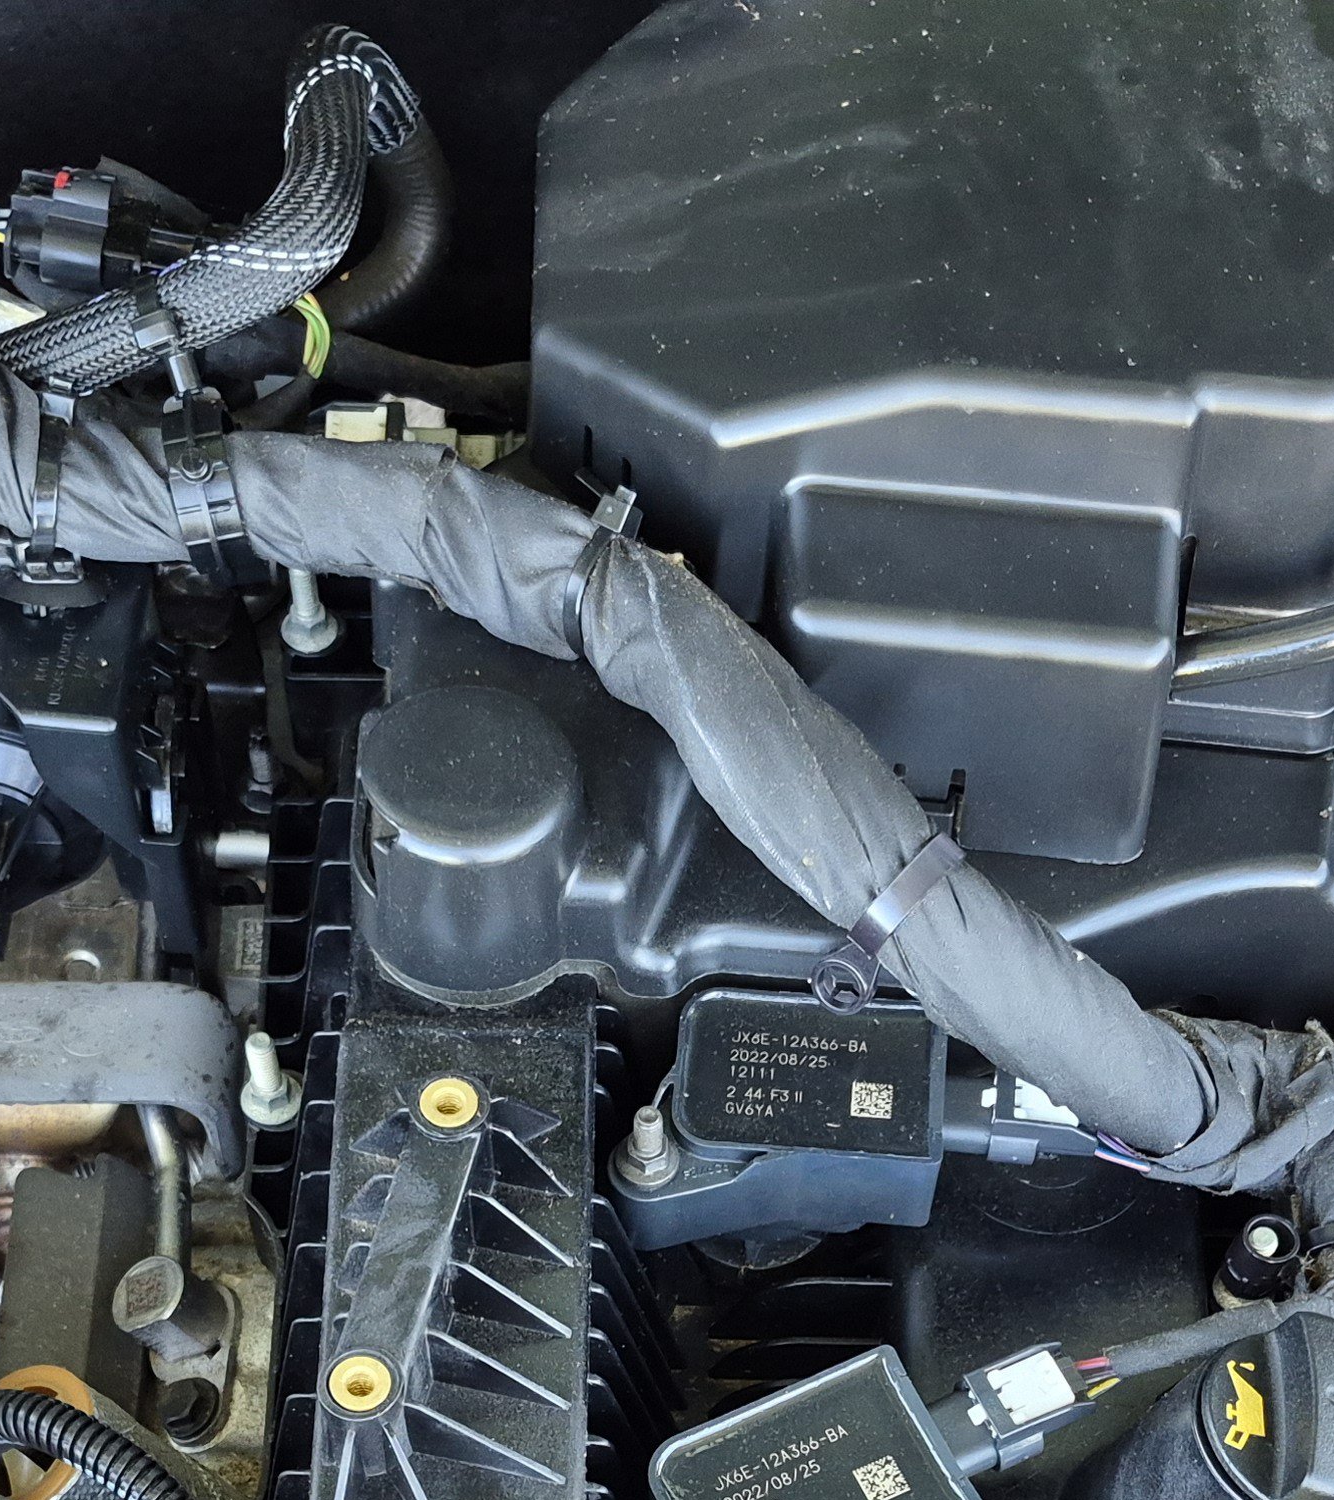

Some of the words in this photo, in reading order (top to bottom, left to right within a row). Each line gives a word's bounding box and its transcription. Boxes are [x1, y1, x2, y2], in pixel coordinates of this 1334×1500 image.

[731, 1031, 868, 1053] JX6E-12A366-BA
[729, 1049, 827, 1068] 2022/08/25
[730, 1065, 775, 1080] 12111
[726, 1085, 736, 1098] 2
[744, 1086, 762, 1100] 44
[770, 1089, 789, 1102] F3
[725, 1102, 774, 1117] GV6YA
[715, 1424, 849, 1492] JX6E-12A366-BA
